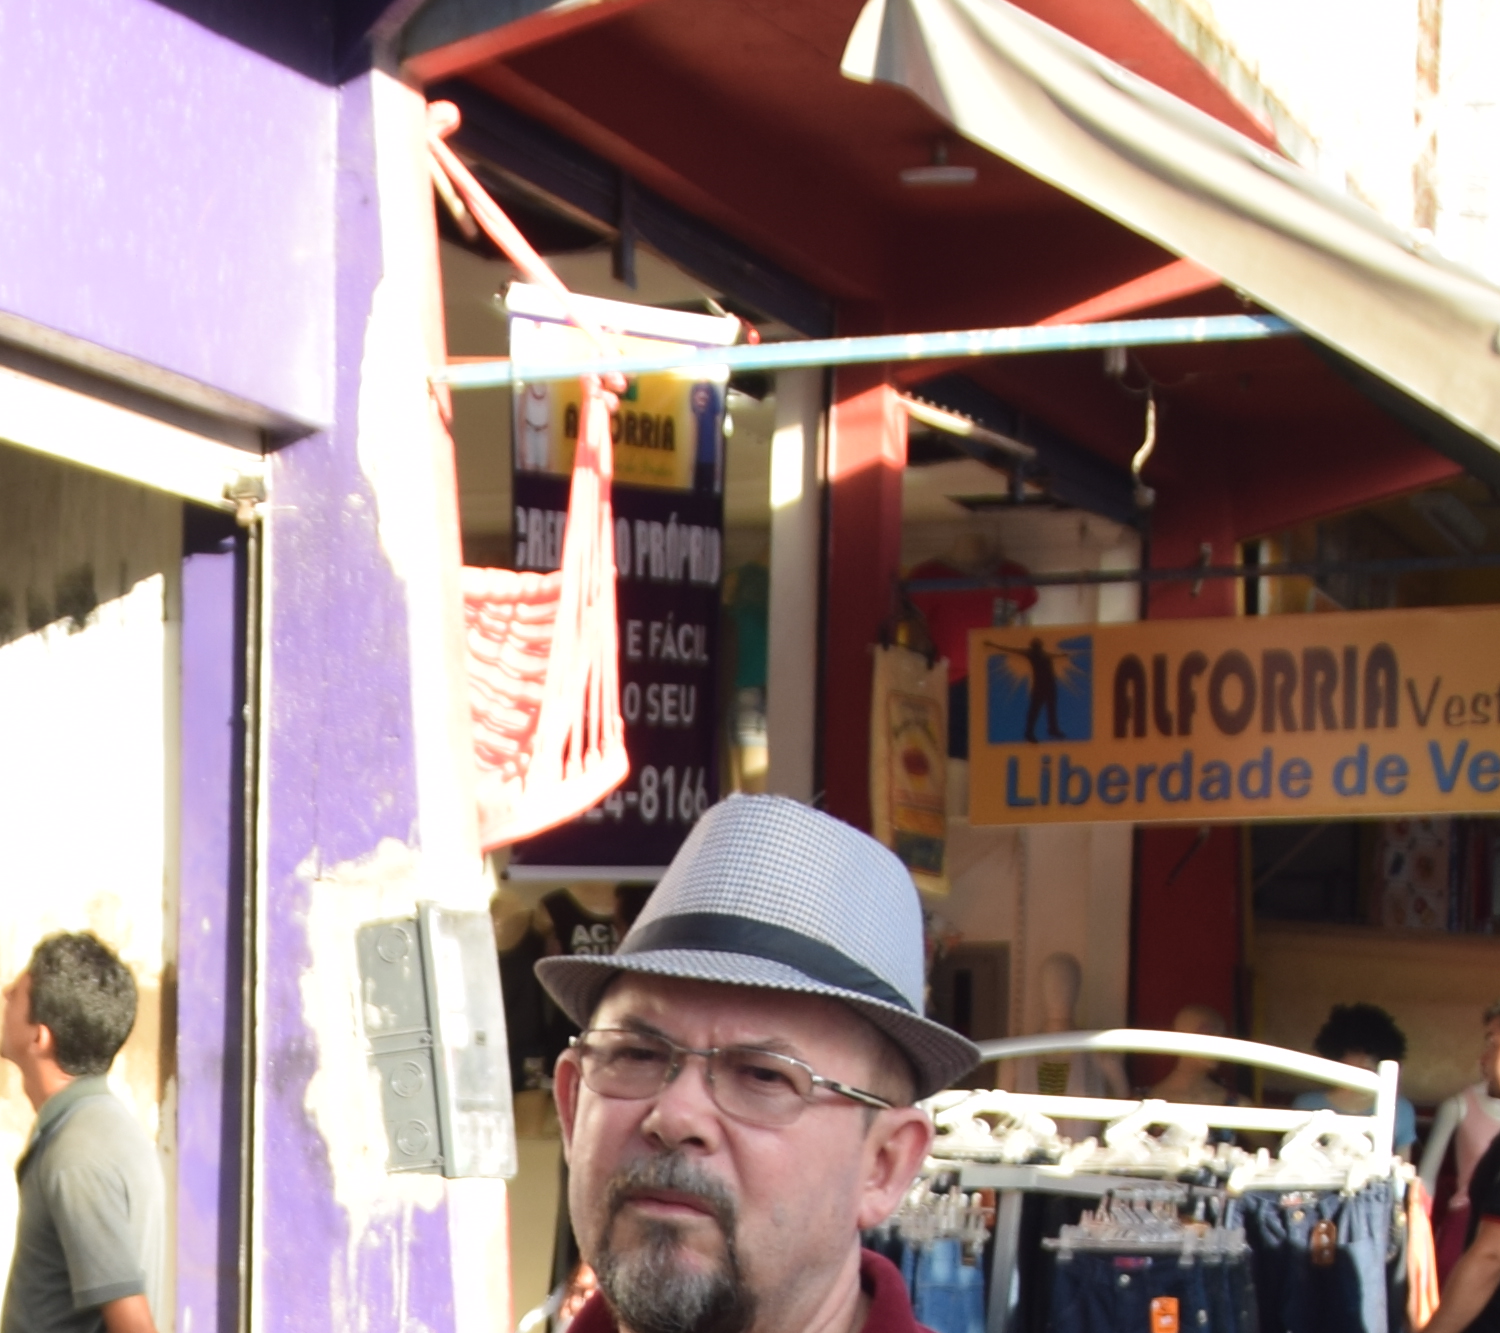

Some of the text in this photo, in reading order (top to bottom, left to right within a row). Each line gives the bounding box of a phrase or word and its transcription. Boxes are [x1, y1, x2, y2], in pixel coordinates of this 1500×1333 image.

[646, 683, 697, 724] SEU
[1112, 642, 1400, 739] ALFORRIA
[1005, 747, 1313, 808] Liberdade
[1332, 743, 1410, 796] de
